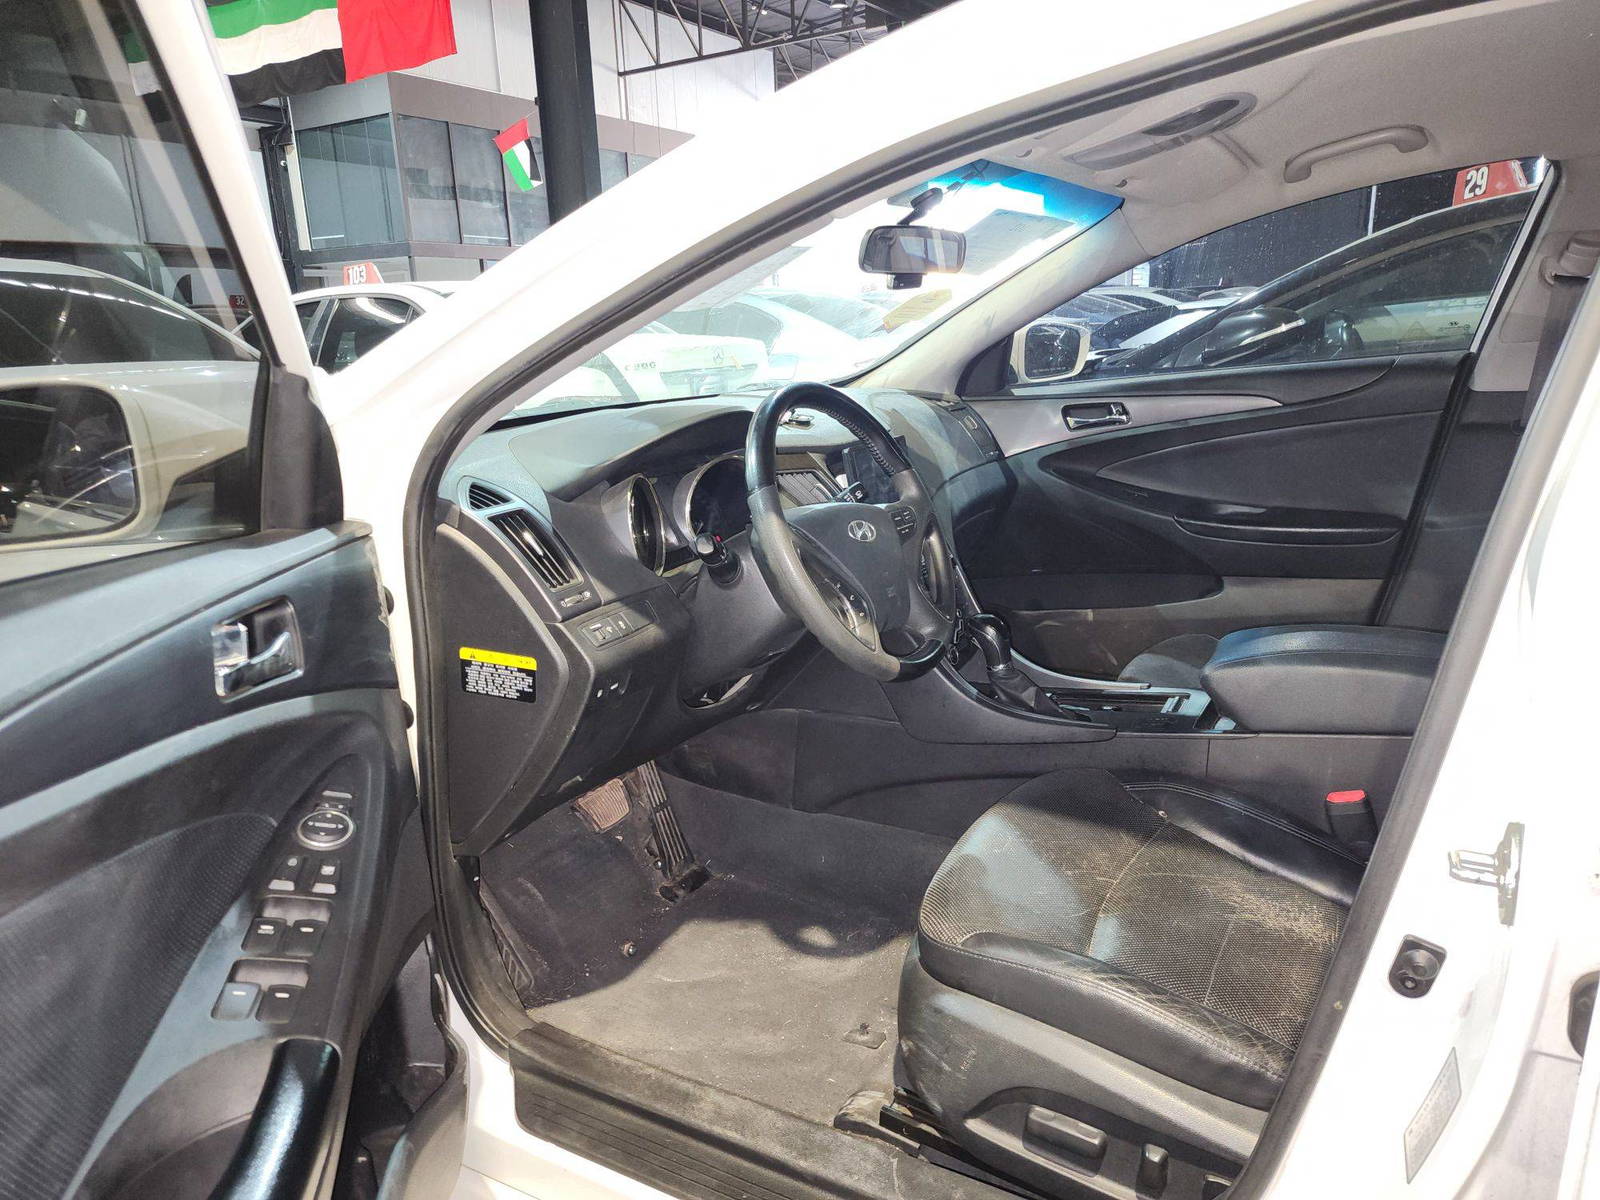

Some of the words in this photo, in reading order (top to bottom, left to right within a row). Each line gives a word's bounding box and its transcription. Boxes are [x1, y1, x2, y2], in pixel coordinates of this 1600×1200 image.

[1463, 165, 1489, 200] 29
[347, 265, 367, 286] 103
[235, 295, 245, 306] 32
